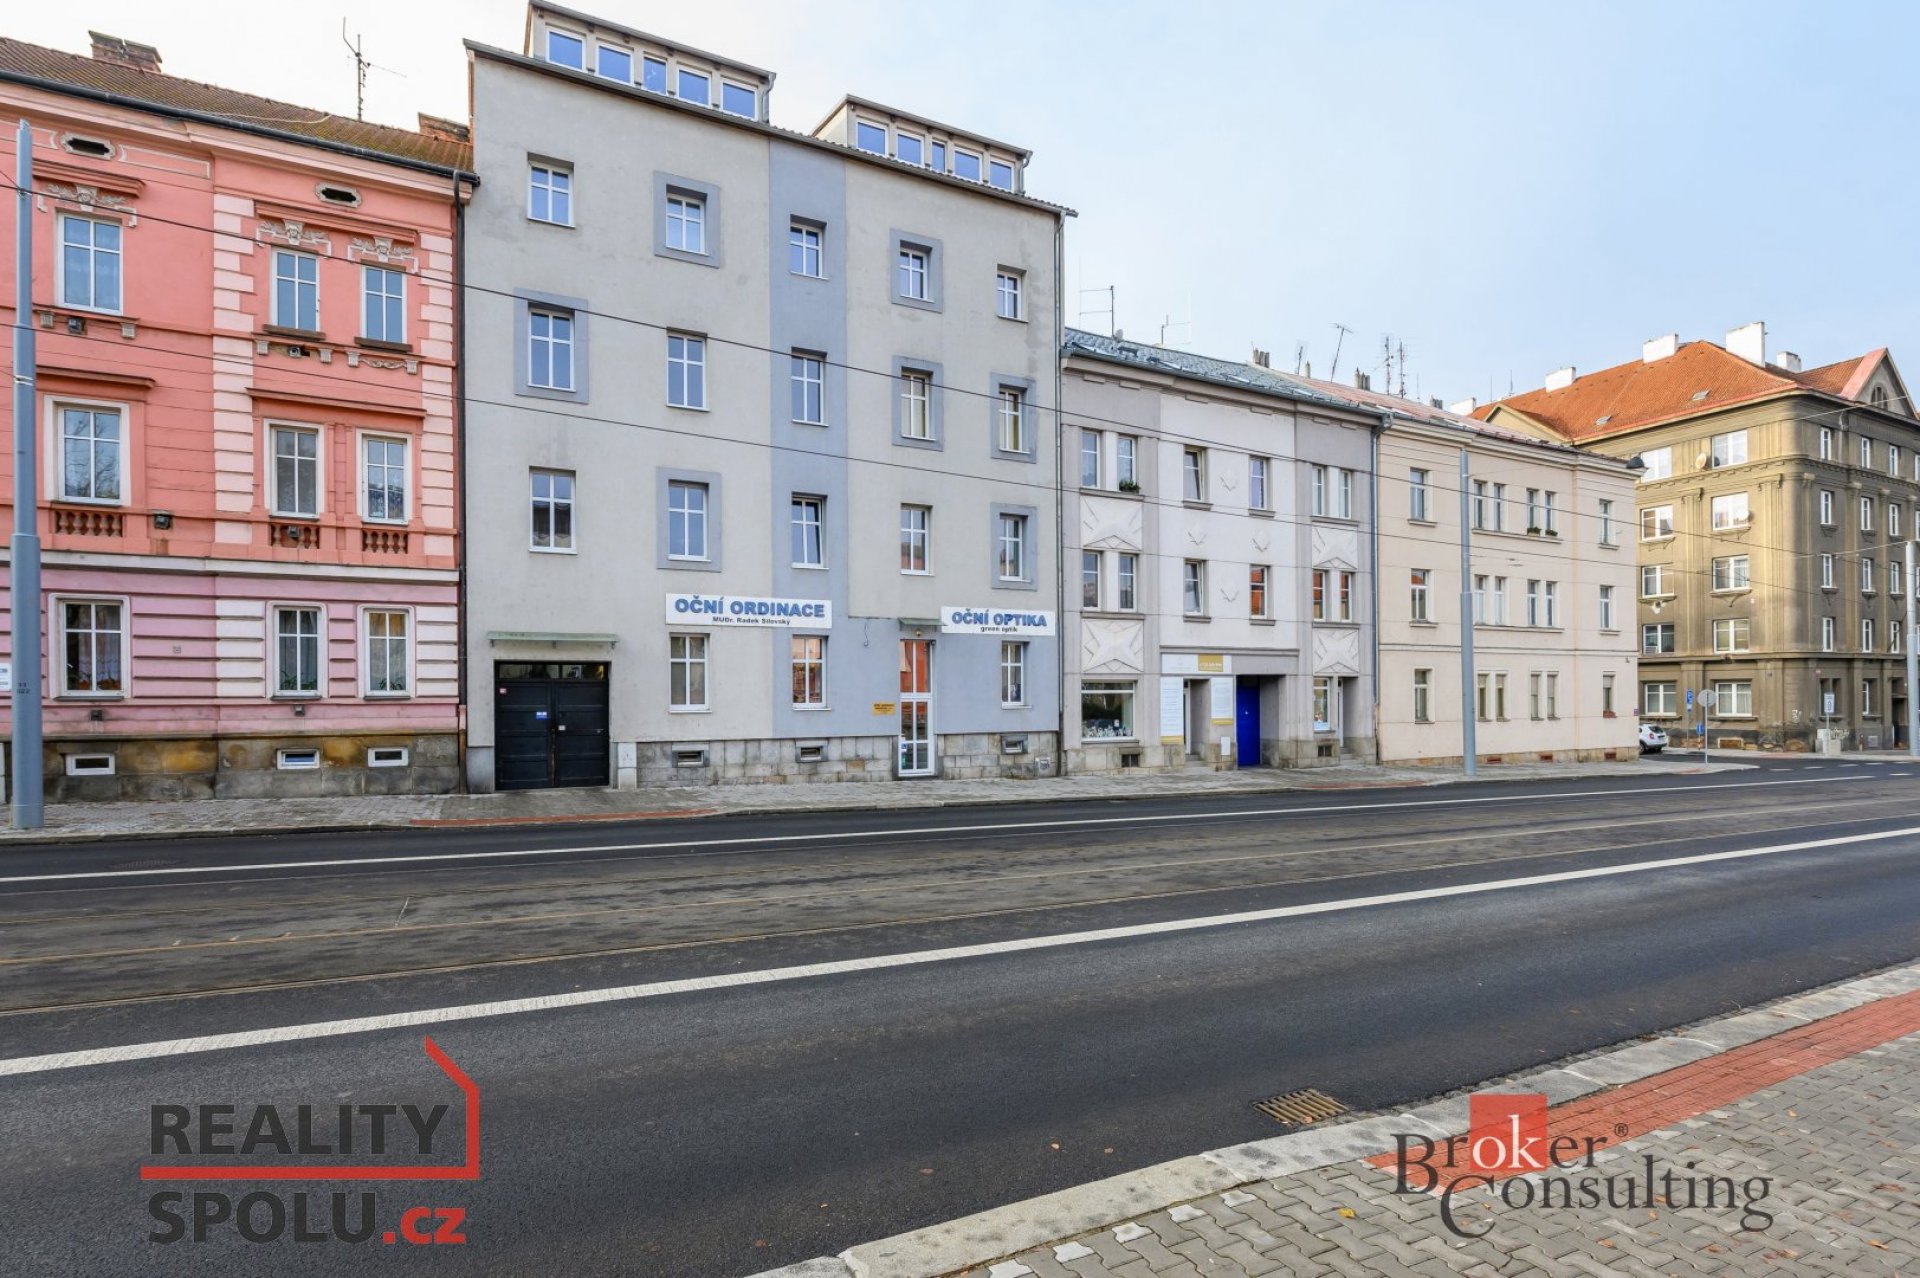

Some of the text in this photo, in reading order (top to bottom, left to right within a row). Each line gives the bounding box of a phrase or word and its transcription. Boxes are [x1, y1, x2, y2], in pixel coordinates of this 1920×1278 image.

[674, 595, 825, 618] OČNÍ ORDINACE
[951, 608, 1048, 627] OČNÍ OPTIKA
